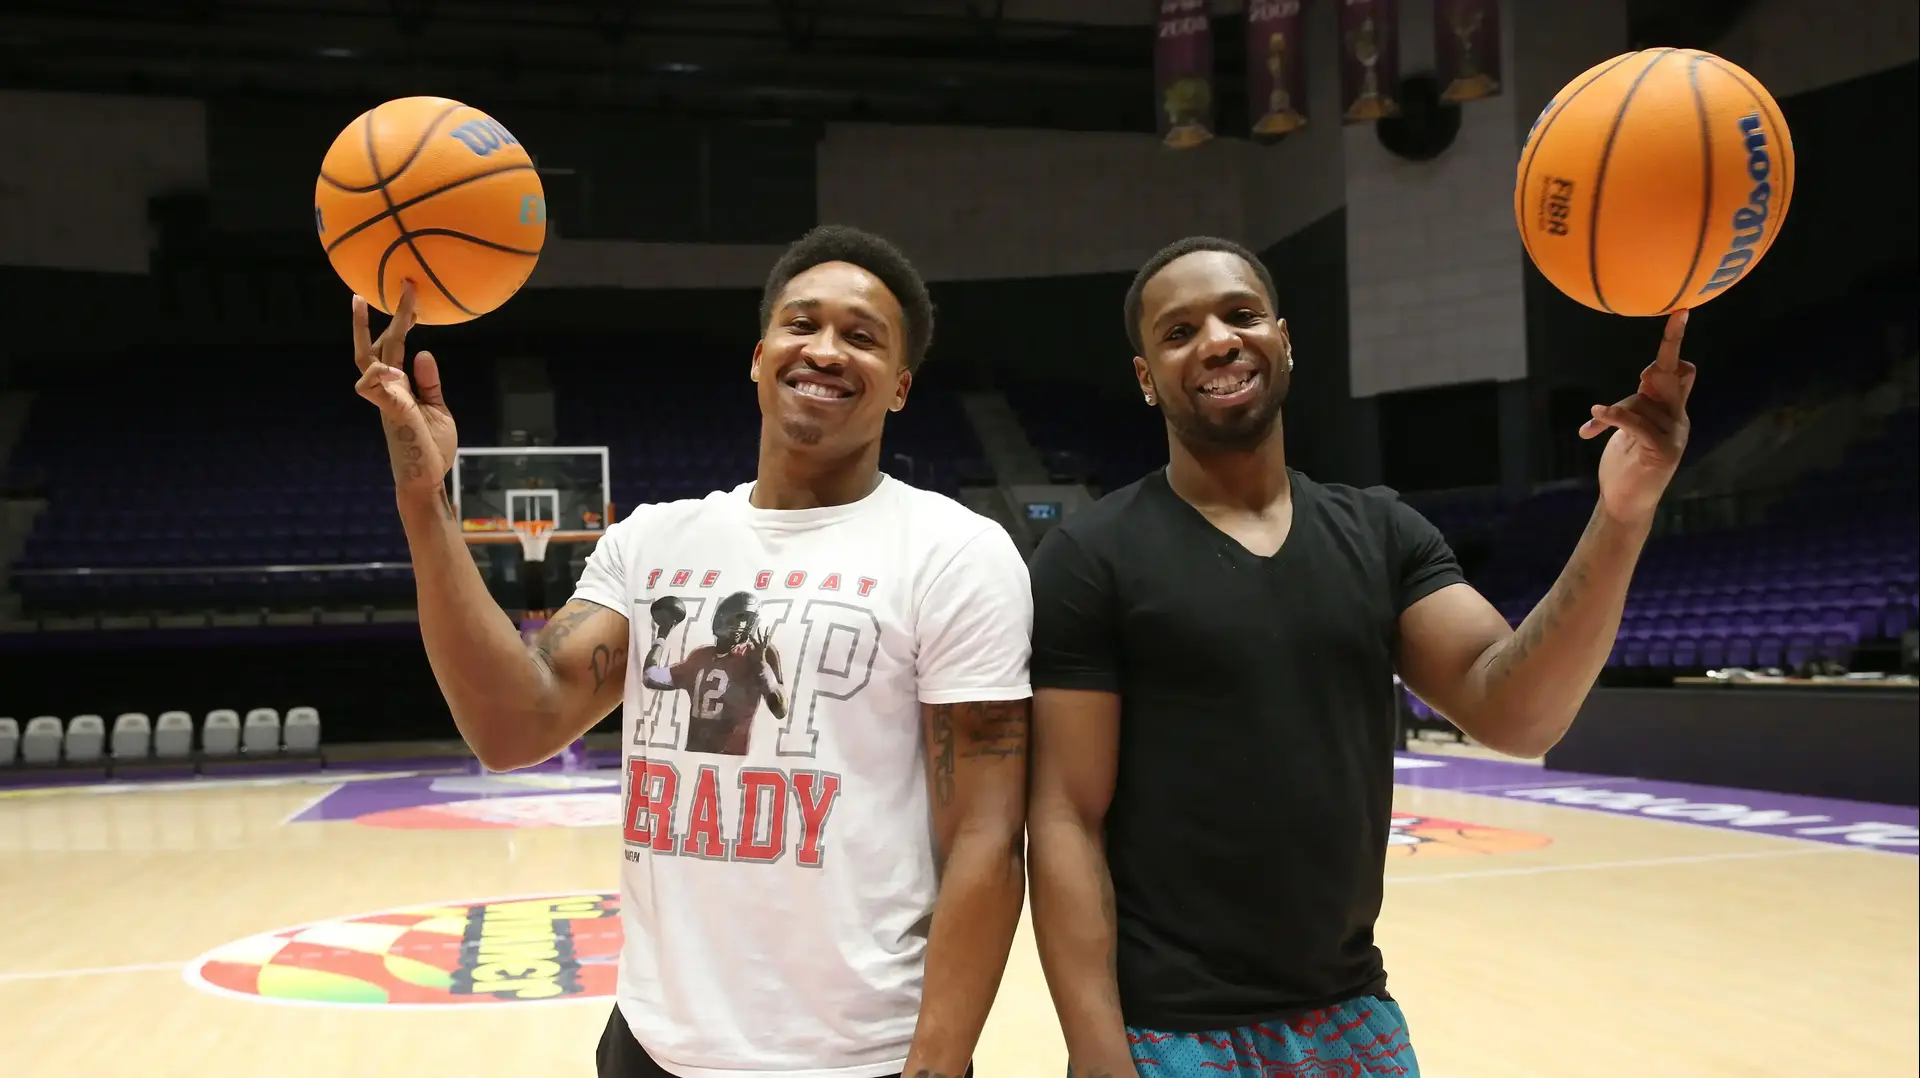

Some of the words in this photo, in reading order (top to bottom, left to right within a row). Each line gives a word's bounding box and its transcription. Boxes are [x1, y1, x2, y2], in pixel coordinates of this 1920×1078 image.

[1699, 112, 1771, 295] Wilson
[646, 568, 720, 590] THE
[755, 569, 878, 597] GOAT
[692, 667, 729, 720] 12
[622, 755, 842, 869] BRADY
